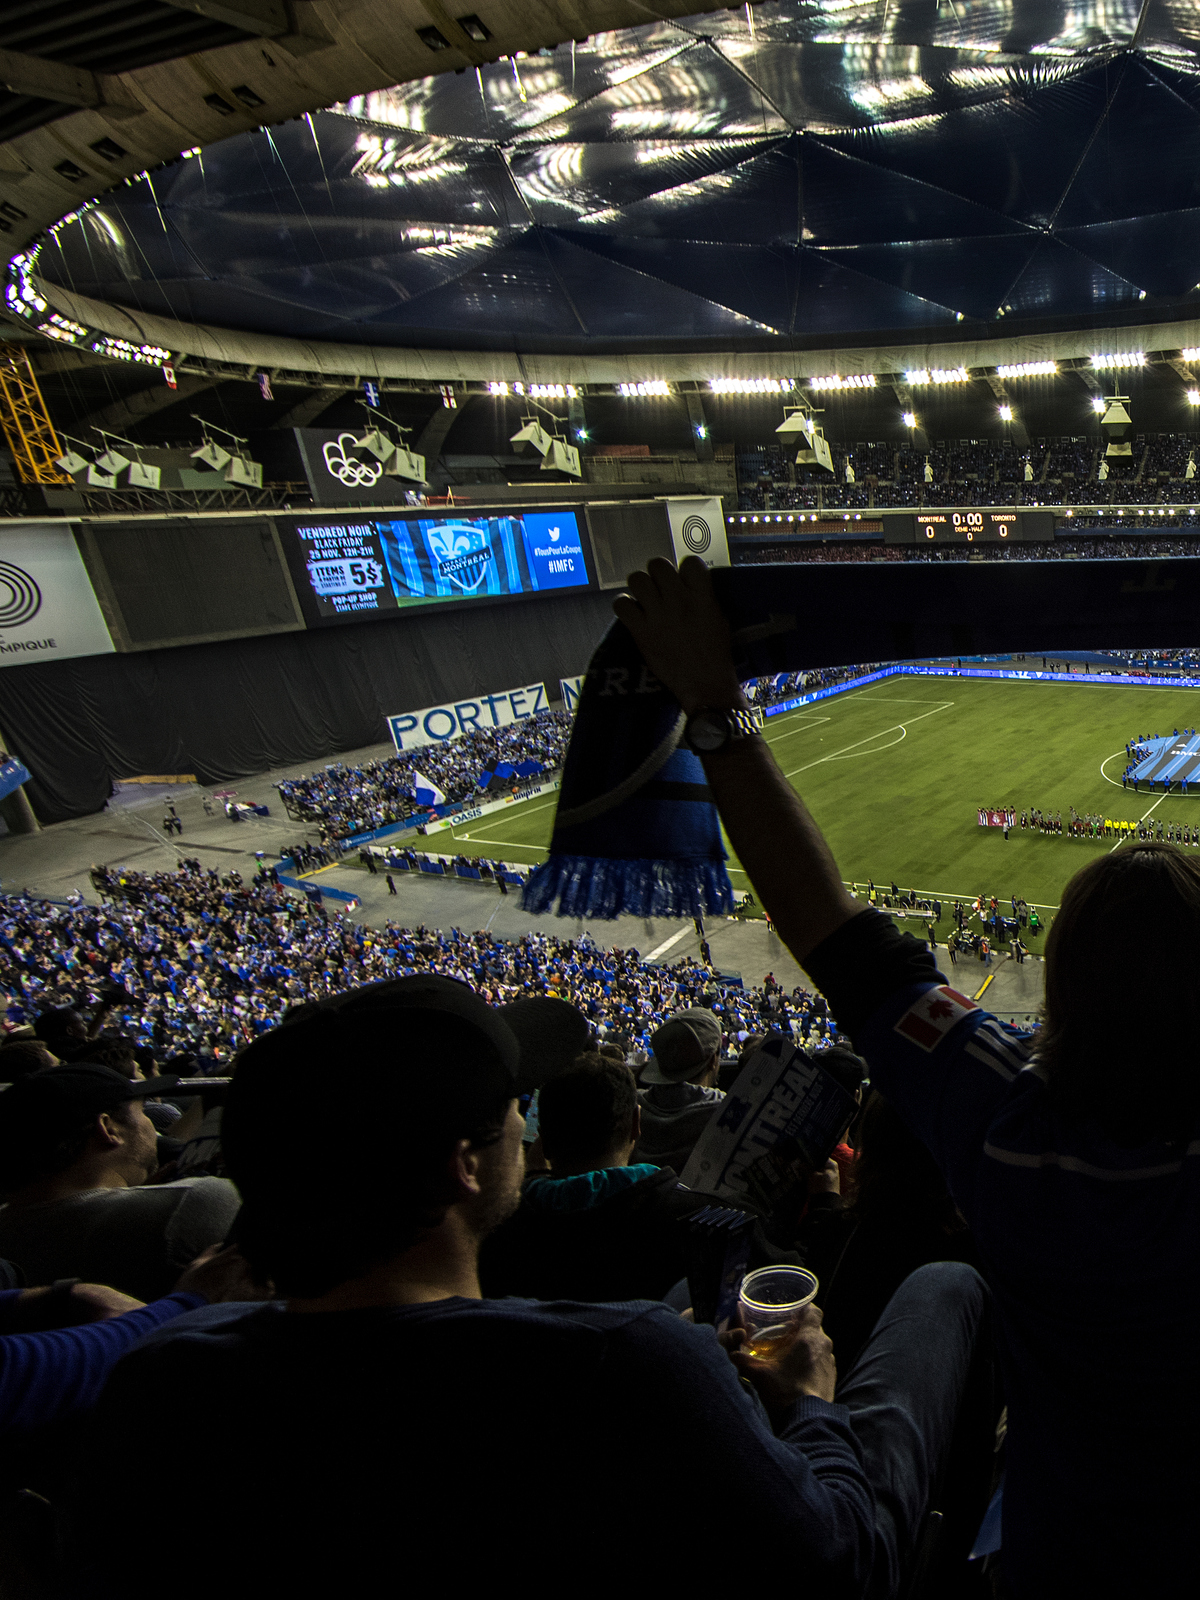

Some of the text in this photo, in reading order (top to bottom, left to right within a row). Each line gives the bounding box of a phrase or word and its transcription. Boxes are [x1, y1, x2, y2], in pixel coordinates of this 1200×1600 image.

[917, 512, 1016, 526] MONTREAL 0:00 TORONTO
[297, 524, 373, 540] VENDREDI NOIR
[925, 525, 935, 539] 0
[967, 532, 973, 541] 0
[999, 523, 1008, 537] 0
[313, 537, 364, 549] BLACK FRIDAY
[320, 548, 342, 559] NOV.
[442, 552, 491, 574] MONTRÉAL
[548, 558, 575, 574] #IMFC
[315, 565, 345, 576] ITEMS
[349, 562, 378, 586] 5$
[331, 592, 378, 605] POP-UP SHOP
[0, 637, 58, 654] MPIQUE
[390, 684, 551, 750] PORTEZ
[452, 807, 482, 825] OASIS
